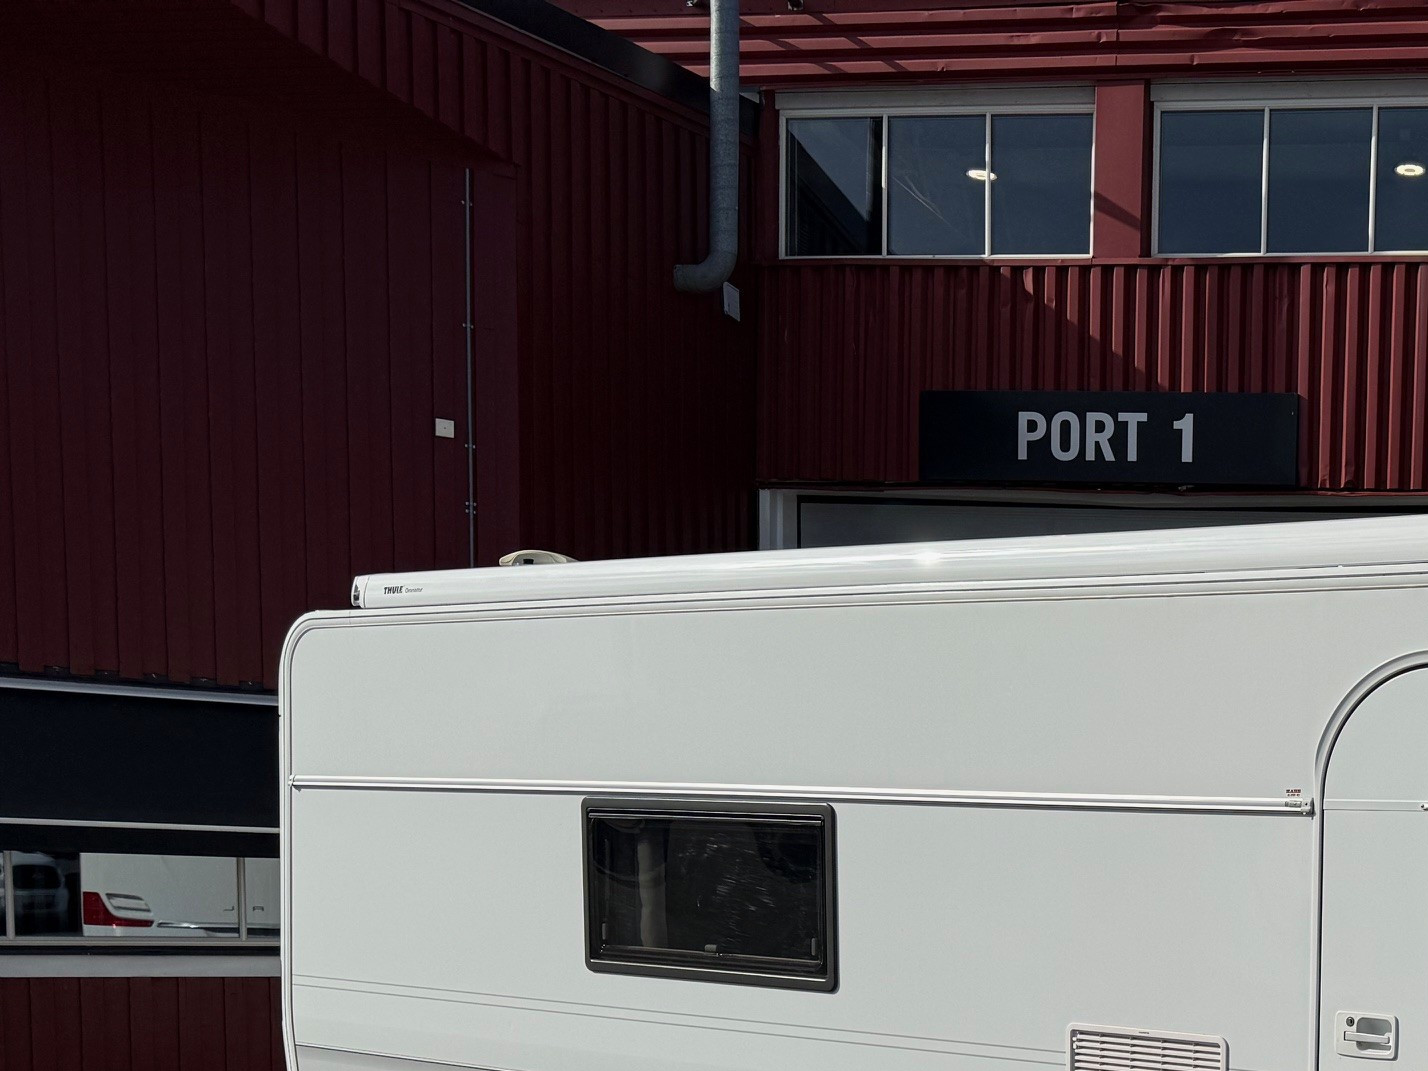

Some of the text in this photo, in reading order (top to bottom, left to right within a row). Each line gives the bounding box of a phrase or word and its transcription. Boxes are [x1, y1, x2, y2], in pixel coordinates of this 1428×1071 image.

[1017, 411, 1194, 463] PORT 1
[384, 585, 404, 595] THULE
